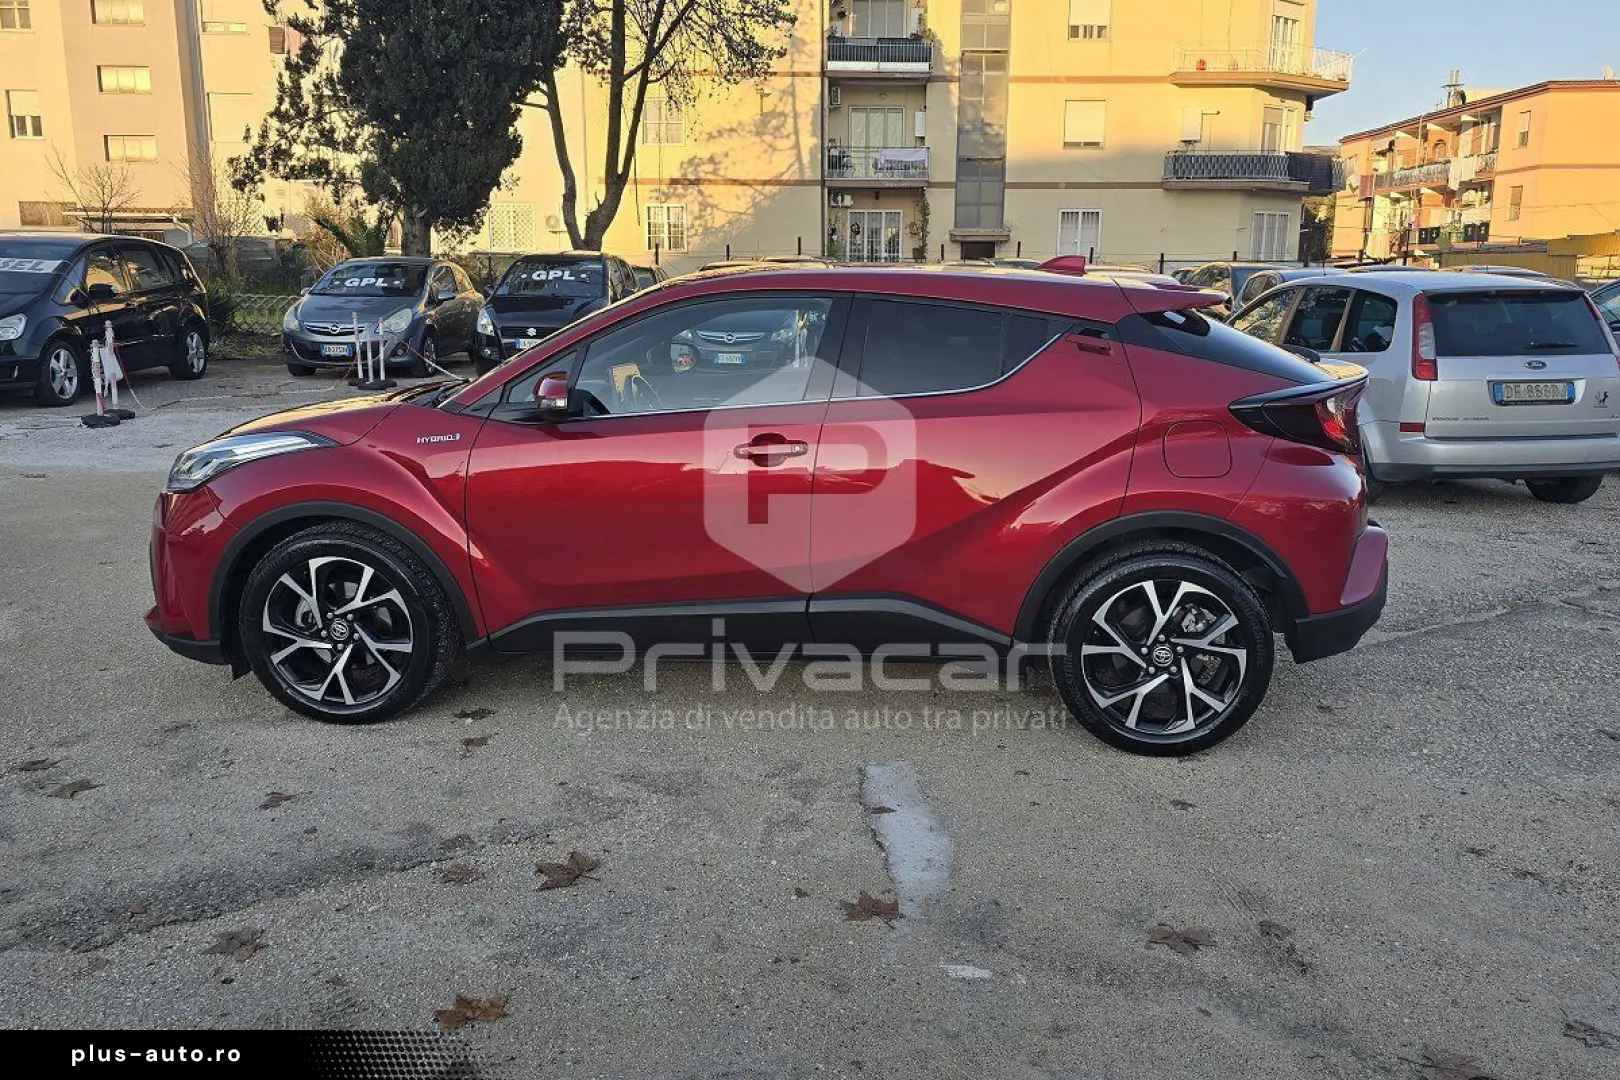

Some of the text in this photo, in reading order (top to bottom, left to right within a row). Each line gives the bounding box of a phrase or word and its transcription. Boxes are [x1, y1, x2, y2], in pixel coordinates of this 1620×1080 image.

[531, 270, 576, 281] GPL
[343, 277, 389, 288] GPL
[416, 434, 455, 444] HYBRID
